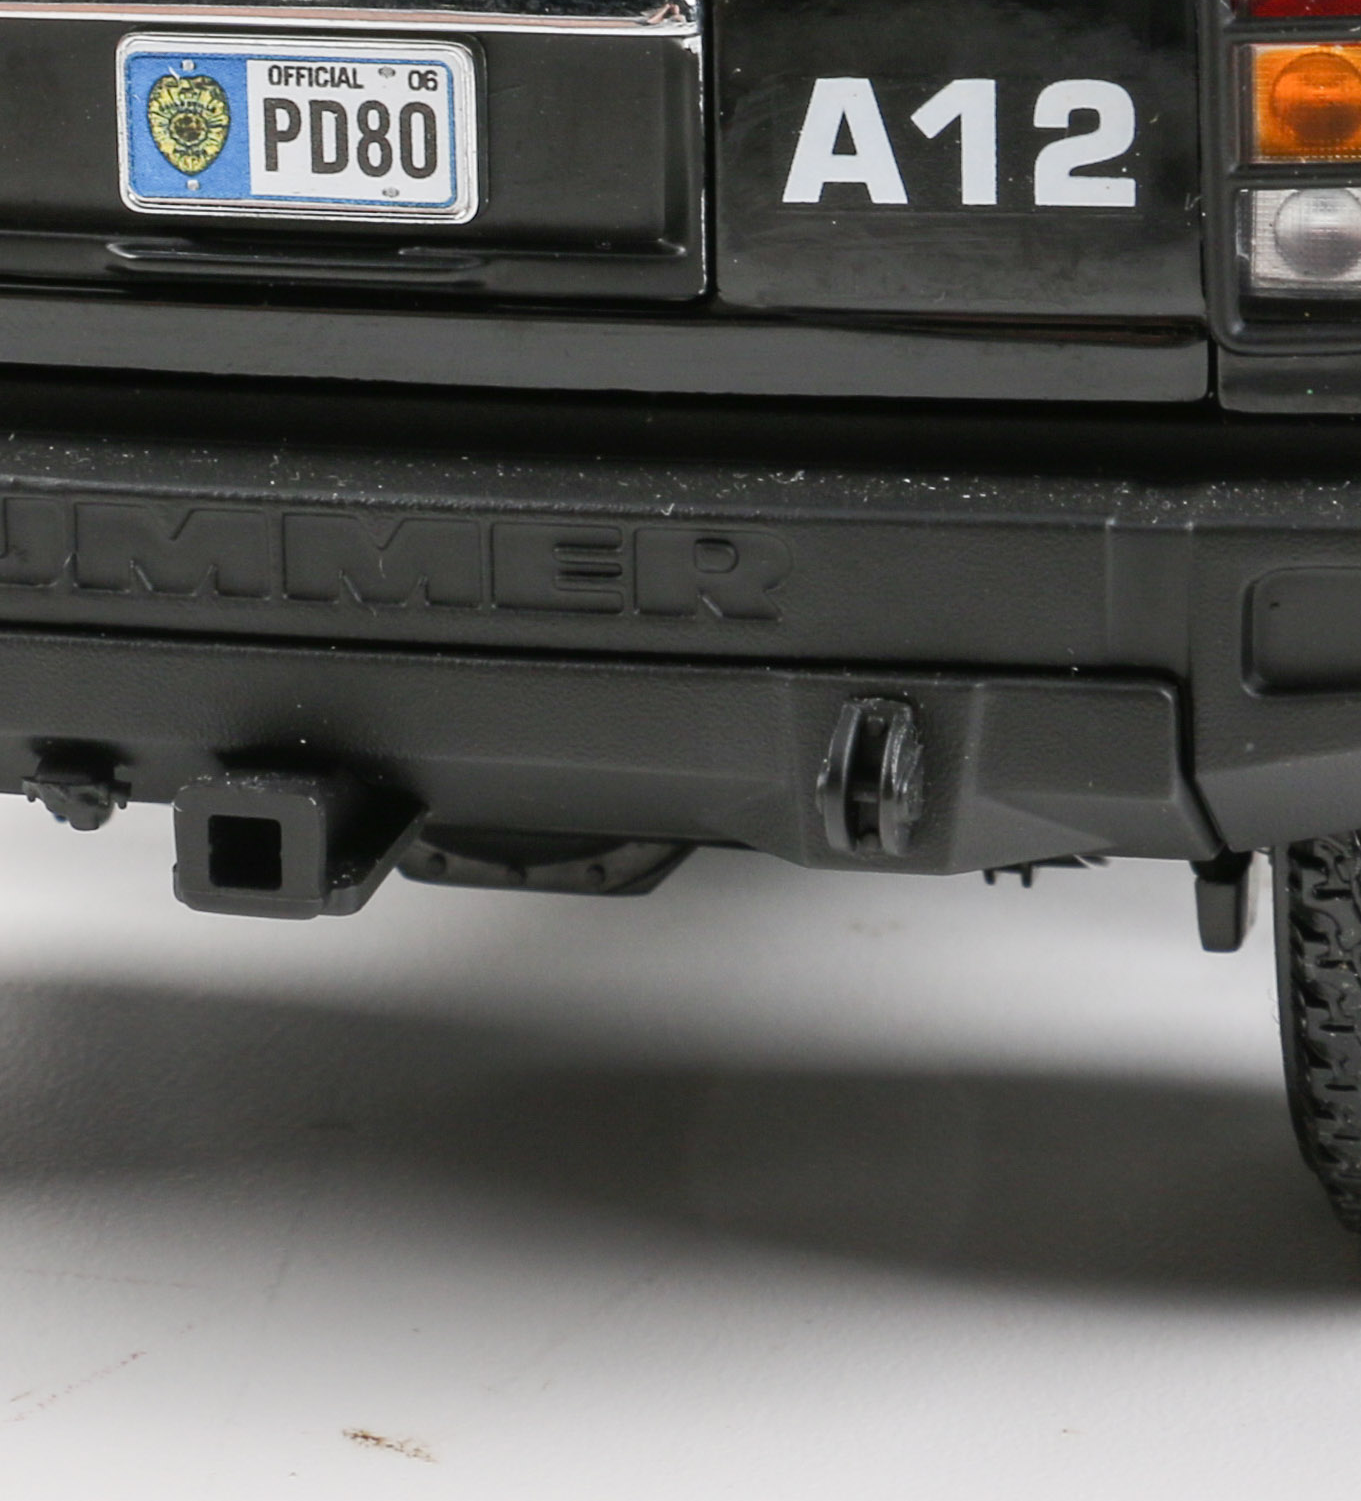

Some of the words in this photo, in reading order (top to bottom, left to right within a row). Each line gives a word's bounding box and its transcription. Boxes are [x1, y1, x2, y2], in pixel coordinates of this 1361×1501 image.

[268, 64, 364, 89] OFFICIAL
[407, 69, 439, 92] 06
[263, 97, 438, 180] PD80
[782, 76, 1137, 207] A12
